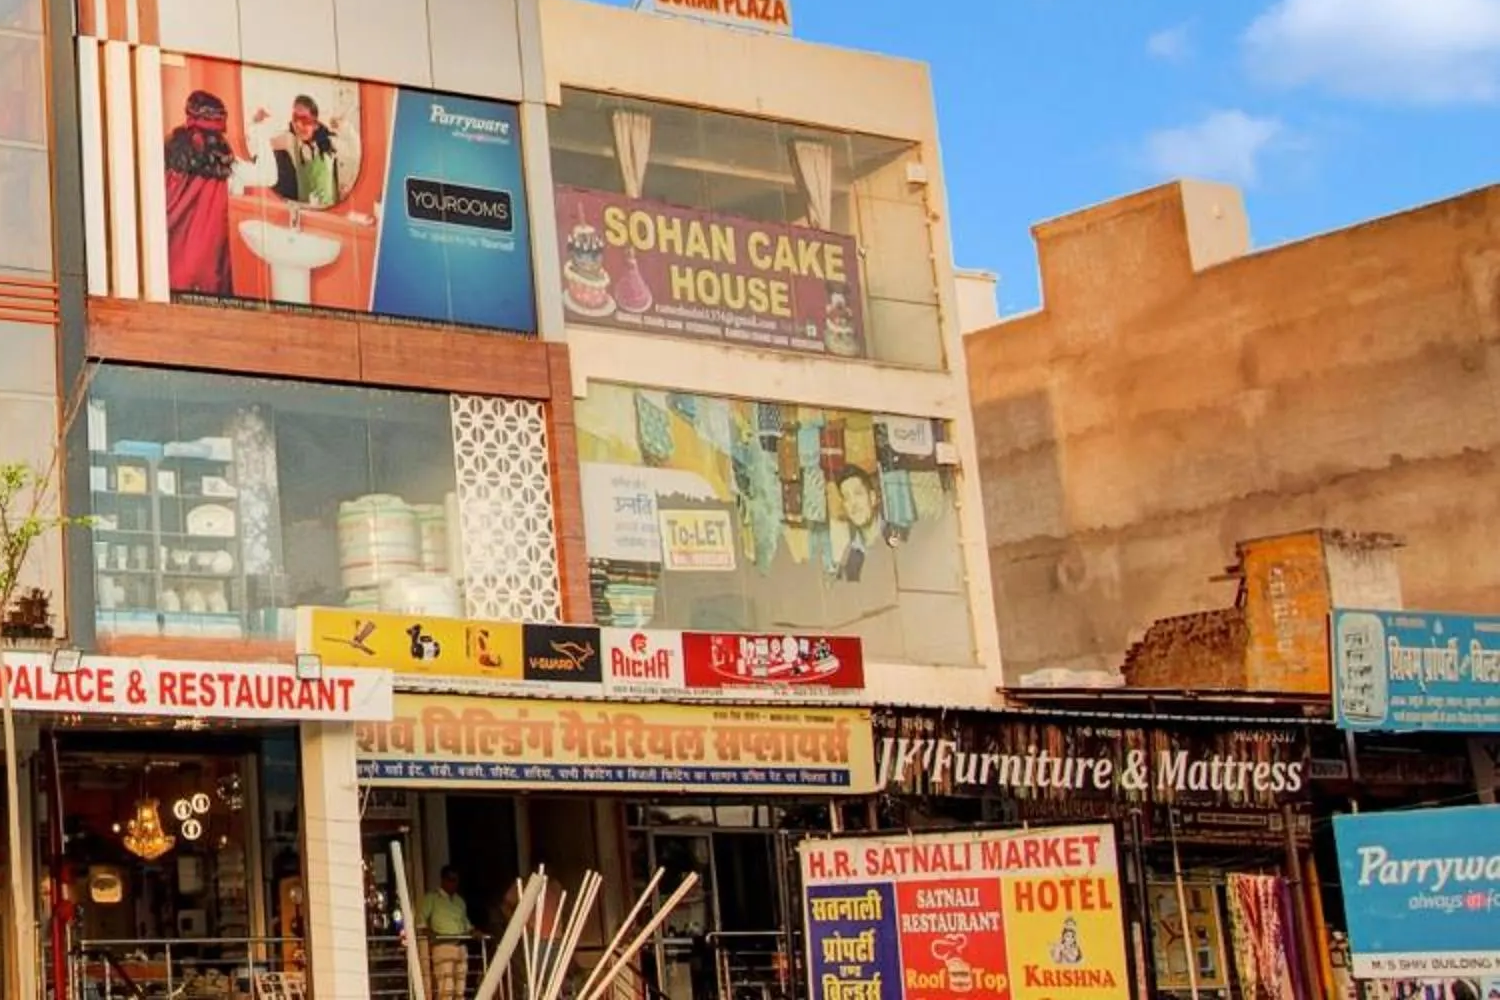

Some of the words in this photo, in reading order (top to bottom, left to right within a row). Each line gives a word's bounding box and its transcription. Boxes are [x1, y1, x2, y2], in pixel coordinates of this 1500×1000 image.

[430, 103, 511, 135] Parryware
[411, 189, 509, 220] YOUROOMS
[603, 205, 737, 265] SOHAN
[748, 230, 847, 283] CAKE
[670, 264, 792, 318] HOUSE
[126, 669, 149, 705] &
[159, 671, 356, 713] RESTAURANT
[421, 705, 556, 758] बिल्डिंग
[710, 716, 851, 765] सप्लायर्स
[929, 740, 1113, 791] Furniture
[1121, 748, 1149, 791] &
[1156, 749, 1303, 793] Mattress
[808, 850, 858, 879] H.R.
[865, 842, 972, 875] SATNALI
[981, 835, 1101, 871] MARKET
[810, 888, 883, 921] सतनाली
[916, 887, 980, 909] SATNALI
[1014, 878, 1114, 913] HOTEL
[902, 912, 1000, 933] RESTAURANT
[906, 967, 945, 990] Roof
[972, 968, 1007, 991] Top
[1024, 964, 1117, 988] KRISHNA
